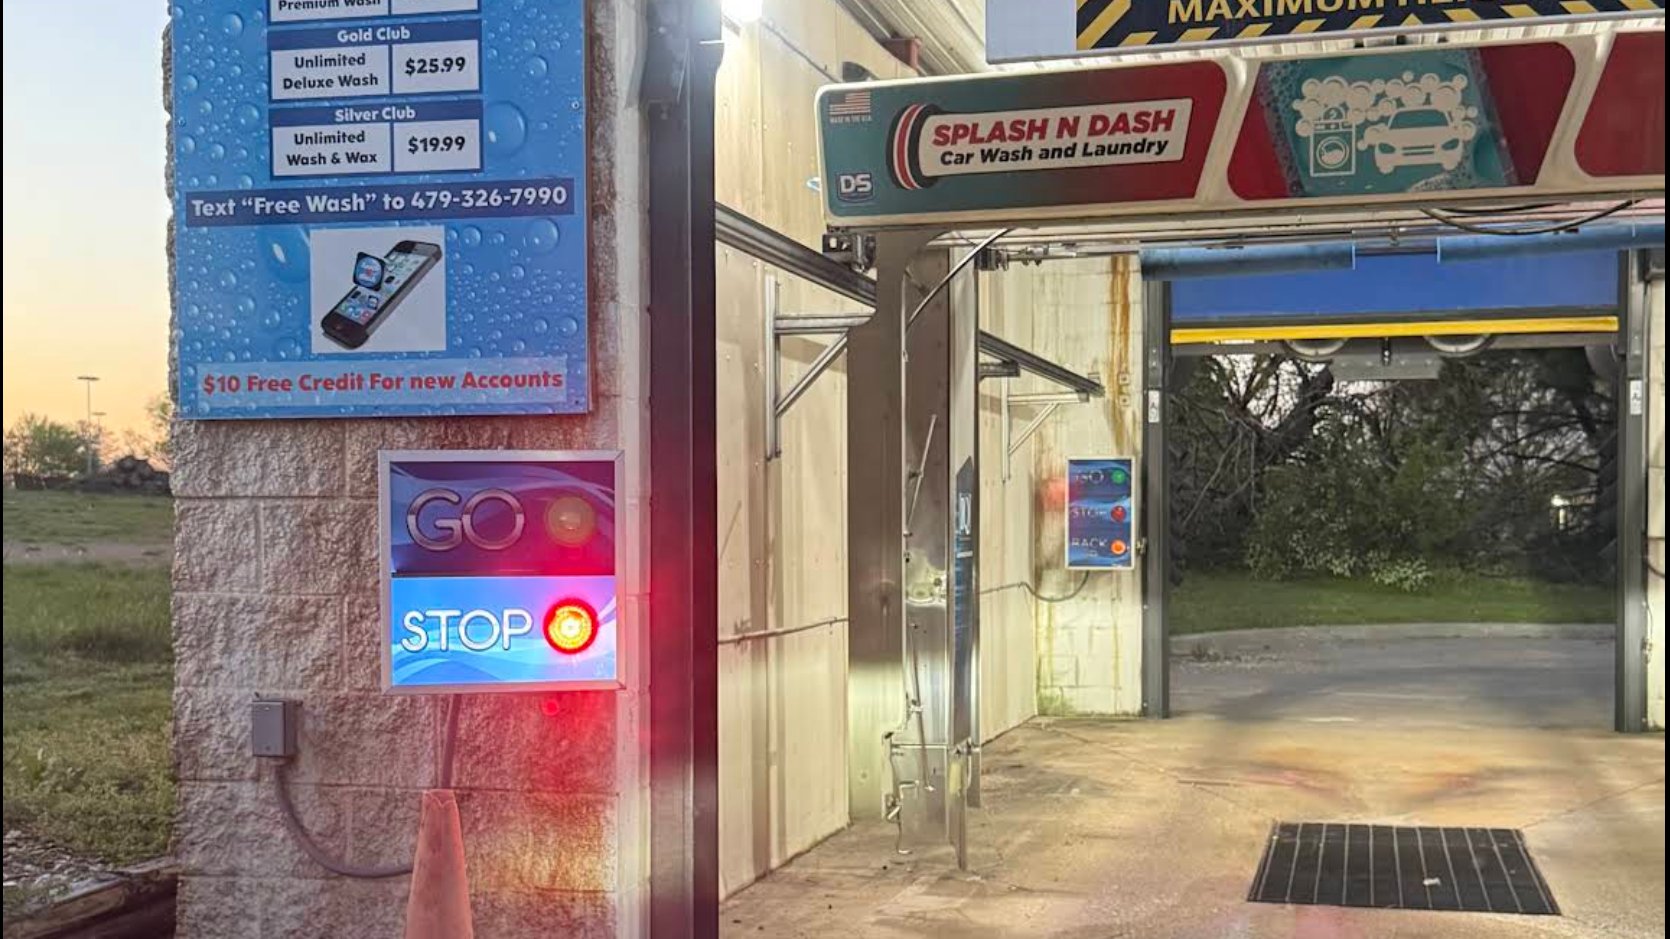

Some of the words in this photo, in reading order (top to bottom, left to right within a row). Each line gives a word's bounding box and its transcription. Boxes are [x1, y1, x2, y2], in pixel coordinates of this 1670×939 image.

[278, 0, 340, 11] Premium
[337, 28, 373, 43] Gold
[376, 26, 411, 41] Club
[294, 53, 366, 69] Unlimited
[405, 57, 466, 77] $25.99
[283, 77, 334, 90] Deluxe
[338, 73, 379, 87] Wash
[335, 108, 378, 122] Silver
[381, 106, 416, 120] Club
[932, 118, 1049, 146] SPLASH
[1056, 116, 1080, 139] N
[1087, 109, 1175, 137] DASH
[294, 130, 366, 146] Unlimited
[408, 136, 466, 155] $19.99
[286, 152, 327, 166] Wash
[331, 153, 341, 165] &
[346, 151, 377, 164] Wax
[940, 150, 974, 166] Car
[980, 145, 1033, 163] Wash
[1038, 142, 1078, 160] and
[1081, 138, 1169, 158] Laundry
[840, 174, 873, 194] DS
[191, 199, 236, 217] Text
[241, 196, 301, 215] “Free
[305, 193, 377, 213] Wash”
[383, 193, 405, 210] to
[411, 186, 567, 210] 479-326-7990
[203, 373, 241, 395] $10
[247, 374, 293, 392] Free
[298, 372, 364, 392] Credit
[370, 373, 404, 390] For
[410, 375, 456, 389] new
[461, 370, 563, 389] Accounts
[407, 488, 525, 551] GO
[400, 608, 533, 653] STOP
